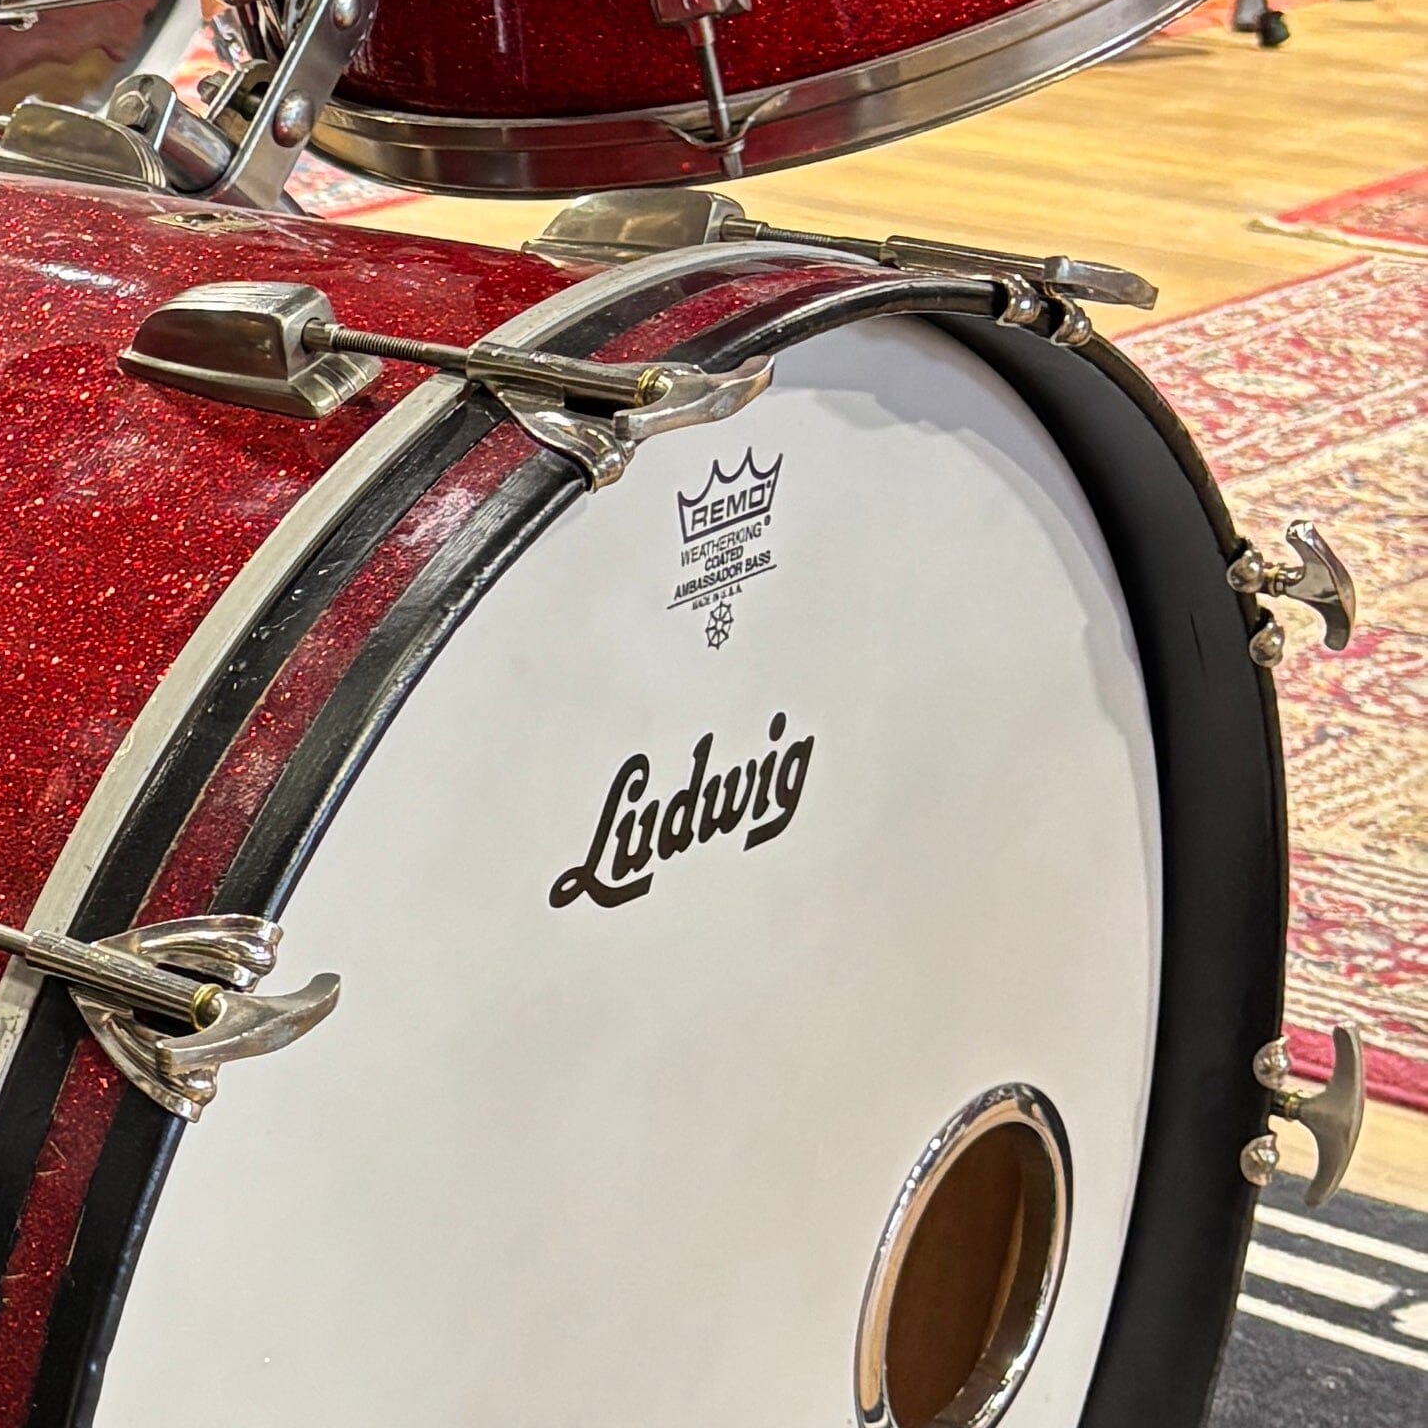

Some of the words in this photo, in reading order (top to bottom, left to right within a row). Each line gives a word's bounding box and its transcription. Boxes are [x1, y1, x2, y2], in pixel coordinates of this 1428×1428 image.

[691, 482, 766, 532] REMO
[674, 562, 744, 601] AMBASSADOR
[744, 550, 772, 573] BASS
[704, 545, 744, 571] COATED
[548, 712, 815, 909] Ludwig
